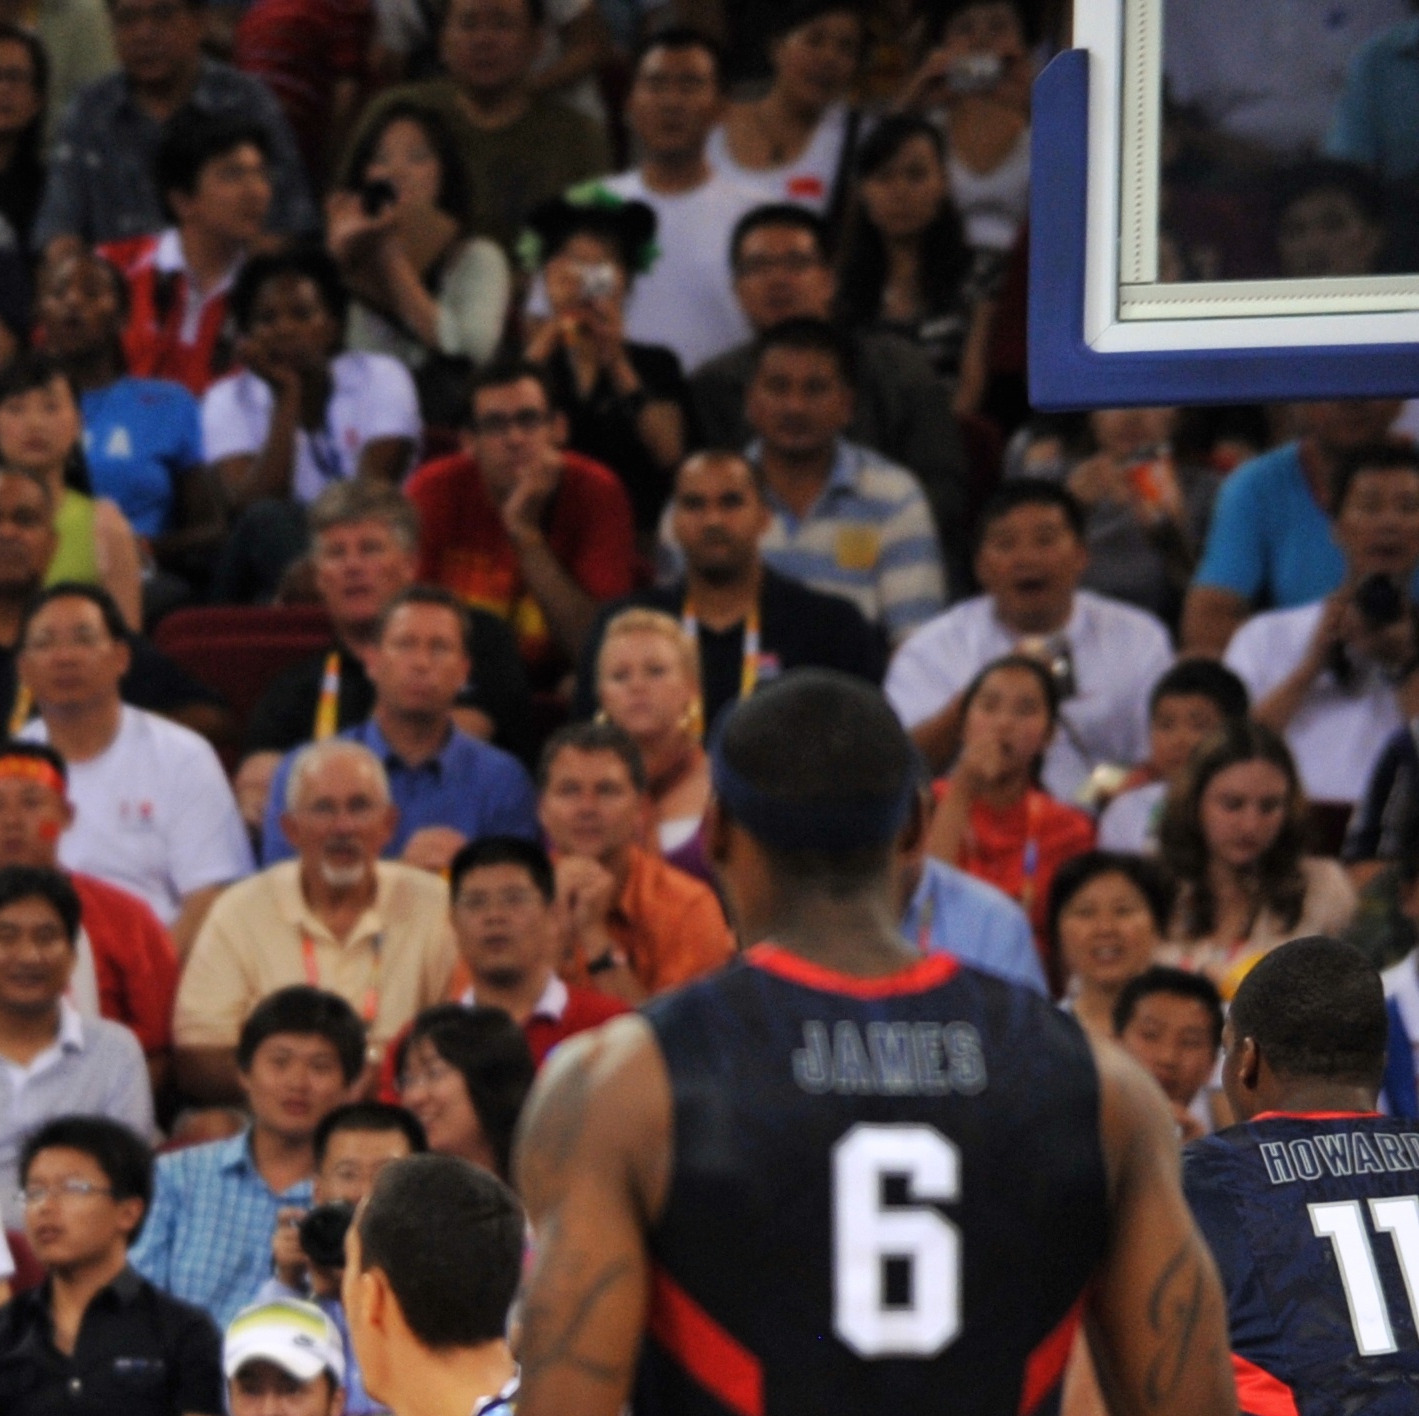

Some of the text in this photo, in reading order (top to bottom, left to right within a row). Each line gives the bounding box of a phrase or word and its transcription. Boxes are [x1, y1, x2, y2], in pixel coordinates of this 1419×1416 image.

[791, 1020, 988, 1096] JAMES
[831, 1121, 963, 1360] 6
[1307, 1195, 1419, 1356] 11
